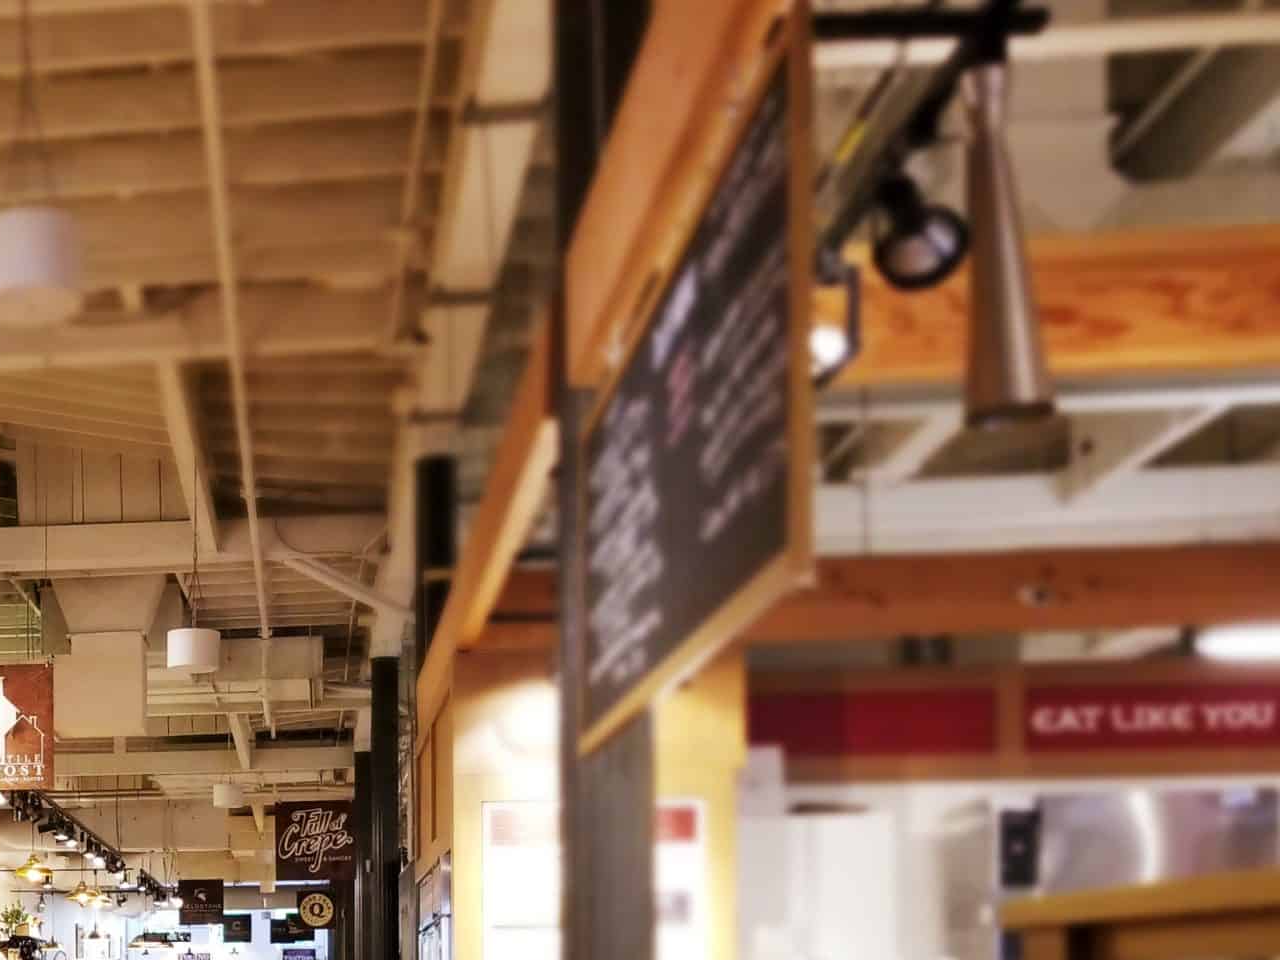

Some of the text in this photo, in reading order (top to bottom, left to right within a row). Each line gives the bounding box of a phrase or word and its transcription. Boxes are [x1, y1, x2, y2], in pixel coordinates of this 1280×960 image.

[1031, 702, 1275, 732] EAT LIKE YOU
